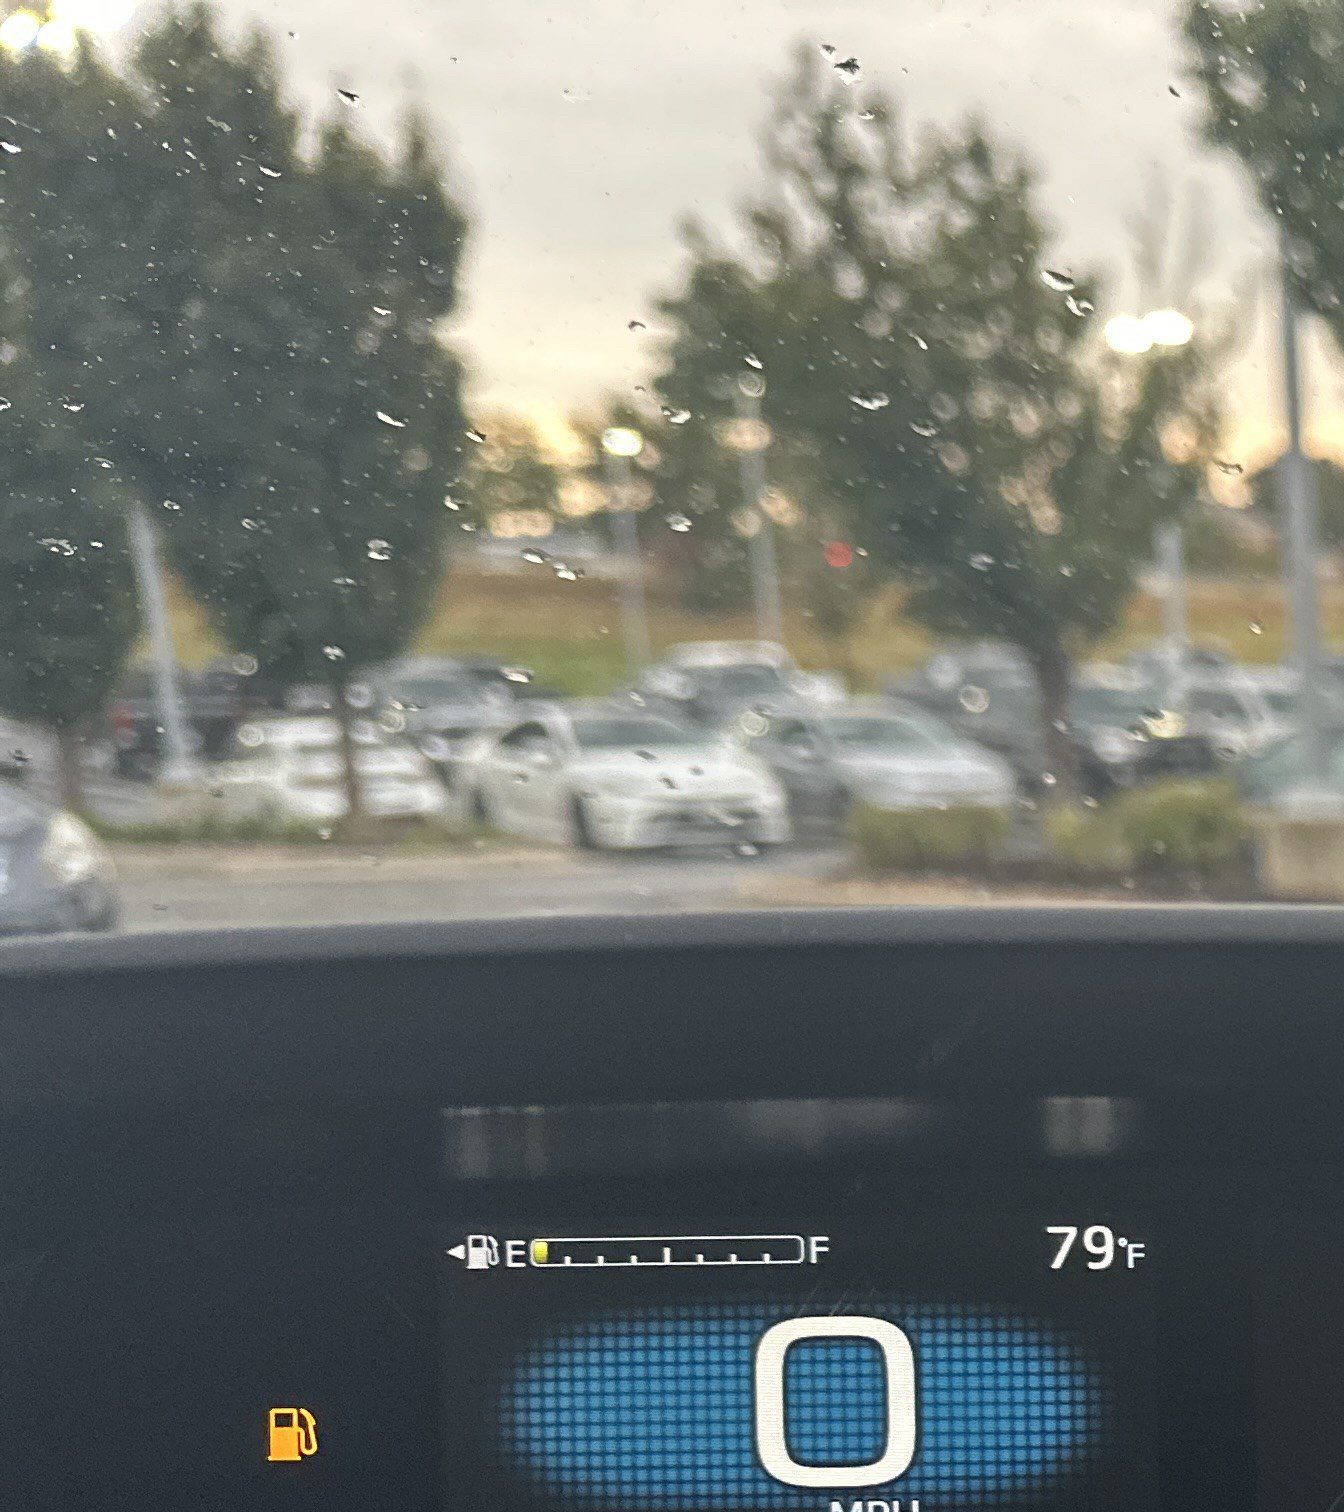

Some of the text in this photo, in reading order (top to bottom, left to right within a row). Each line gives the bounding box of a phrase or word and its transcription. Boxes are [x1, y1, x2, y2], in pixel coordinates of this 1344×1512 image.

[506, 1240, 526, 1267] E
[810, 1236, 829, 1263] F
[756, 1317, 915, 1486] 0
